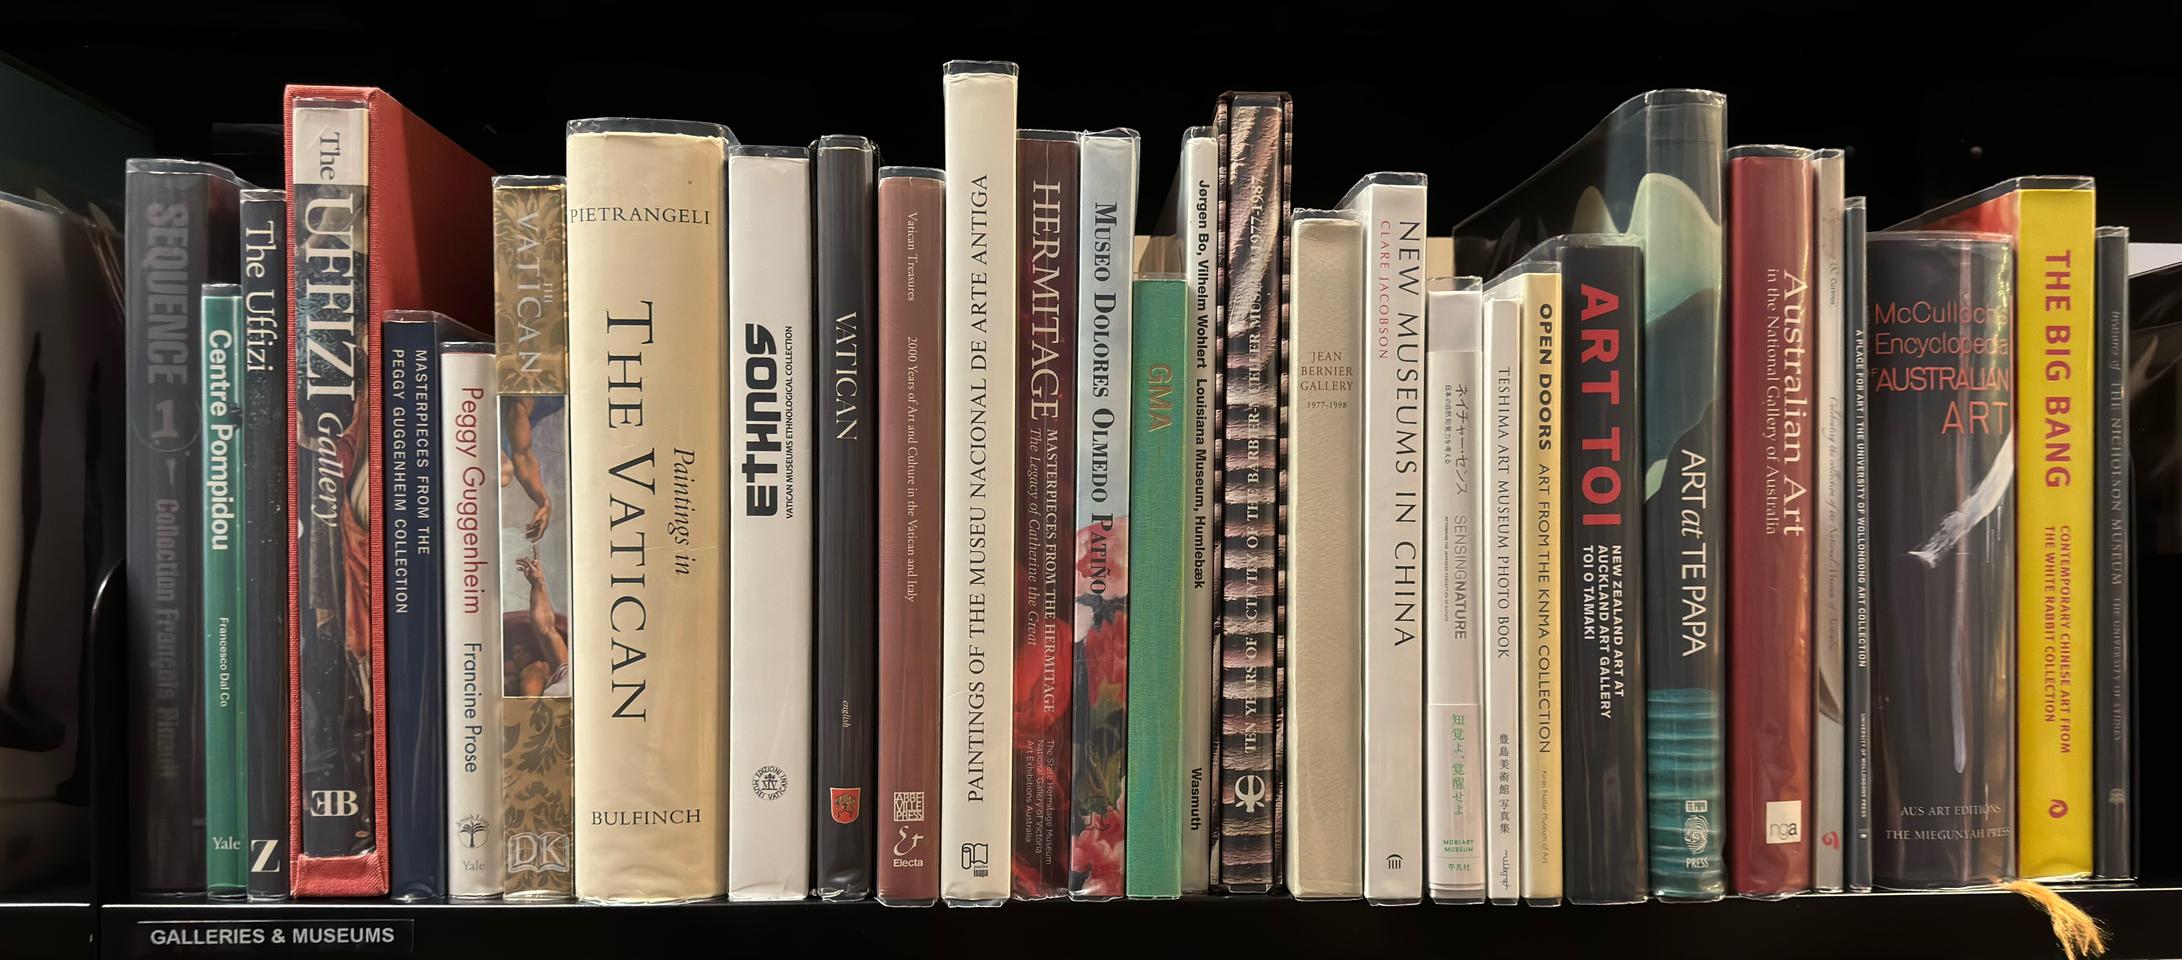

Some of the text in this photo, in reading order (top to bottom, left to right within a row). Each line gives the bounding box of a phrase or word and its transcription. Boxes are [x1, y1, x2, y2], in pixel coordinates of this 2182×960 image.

[142, 203, 189, 385] SEQUENCE
[245, 220, 278, 373] The Uffizi
[304, 131, 356, 401] The UFFIZI
[514, 210, 542, 374] VATICAN
[569, 207, 712, 225] PIETRANGELI
[906, 211, 919, 302] Vatican Treasures
[1196, 179, 1210, 369] Jørgen Bo, Vilhelm Wohlert
[1379, 220, 1391, 360] CLARE JACOBSON
[835, 311, 859, 440] VATICAN
[1031, 180, 1061, 421] HERMITAGE
[1301, 366, 1353, 376] BERNIER
[1312, 351, 1342, 363] JEAN
[1875, 367, 2010, 392] AUSTRALIAN
[2044, 249, 2072, 488] THE BIG BANG
[207, 329, 235, 551] Centre Pompidou
[415, 349, 431, 555] MASTERPIECES FROM THE
[785, 325, 795, 519] VATICAN MUSEUMS ETHNOLOGICAL COLLECTION
[1147, 362, 1175, 433] GMA
[1300, 380, 1353, 391] GALLERY
[1394, 221, 1422, 647] NEW MUSEUMS IN CHINA
[1580, 283, 1622, 526] ART TOI
[1760, 268, 1780, 535] in the National Gallery of Australia
[1783, 268, 1809, 537] Australian Art
[1941, 400, 2009, 435] ART
[311, 411, 345, 528] Gallery
[391, 348, 409, 614] PEGGY GUGGENHEIM COLLECTION
[455, 387, 489, 615] Peggy Guggenheim
[605, 300, 656, 723] THE VATICAN
[668, 448, 696, 576] Paintings in
[904, 336, 919, 602] 2000 Years of Art and Culture in the Vatican and Italy
[967, 174, 988, 802] PAINTINGS OF THE MUSEU NACIONAL DE ARTE ANTIGA
[1026, 427, 1042, 647] The Legacy of Catherine the Great
[1193, 378, 1208, 589] Louisiana Museum, Humlebæk
[1497, 365, 1511, 659] TESHIMA ART MUSEUM PHOTO BOOK
[1538, 303, 1553, 753] OPEN DOORS ART FROM THE KNMA COLLECTION
[1043, 428, 1058, 714] MASTERPIECES FROM THE HERMITAGE
[1598, 545, 1612, 719] AUCKLAND ART GALLERY
[1612, 545, 1625, 697] NEW ZEALAND ART AT
[1681, 449, 1707, 657] ART at TE PAPA
[2044, 526, 2057, 723] THE WHITE RABBIT COLLECTION
[2111, 518, 2124, 586] MUSEUM
[219, 617, 231, 708] Francesco Dal Co
[463, 642, 483, 773] Francine Prose
[841, 701, 852, 728] english
[2059, 525, 2072, 754] CONTEMPORARY CHINESE ART FROM
[212, 837, 241, 850] Yale
[591, 808, 702, 826] BULFINCH
[1034, 740, 1045, 854] National Gallery of Victoria
[1044, 740, 1055, 865] The State Hermitage Museum
[1190, 767, 1203, 831] Wasmuth
[1686, 857, 1709, 869] PRESS
[1770, 822, 1798, 841] nga
[150, 927, 395, 945] GALLERIES & MUSEUMS
